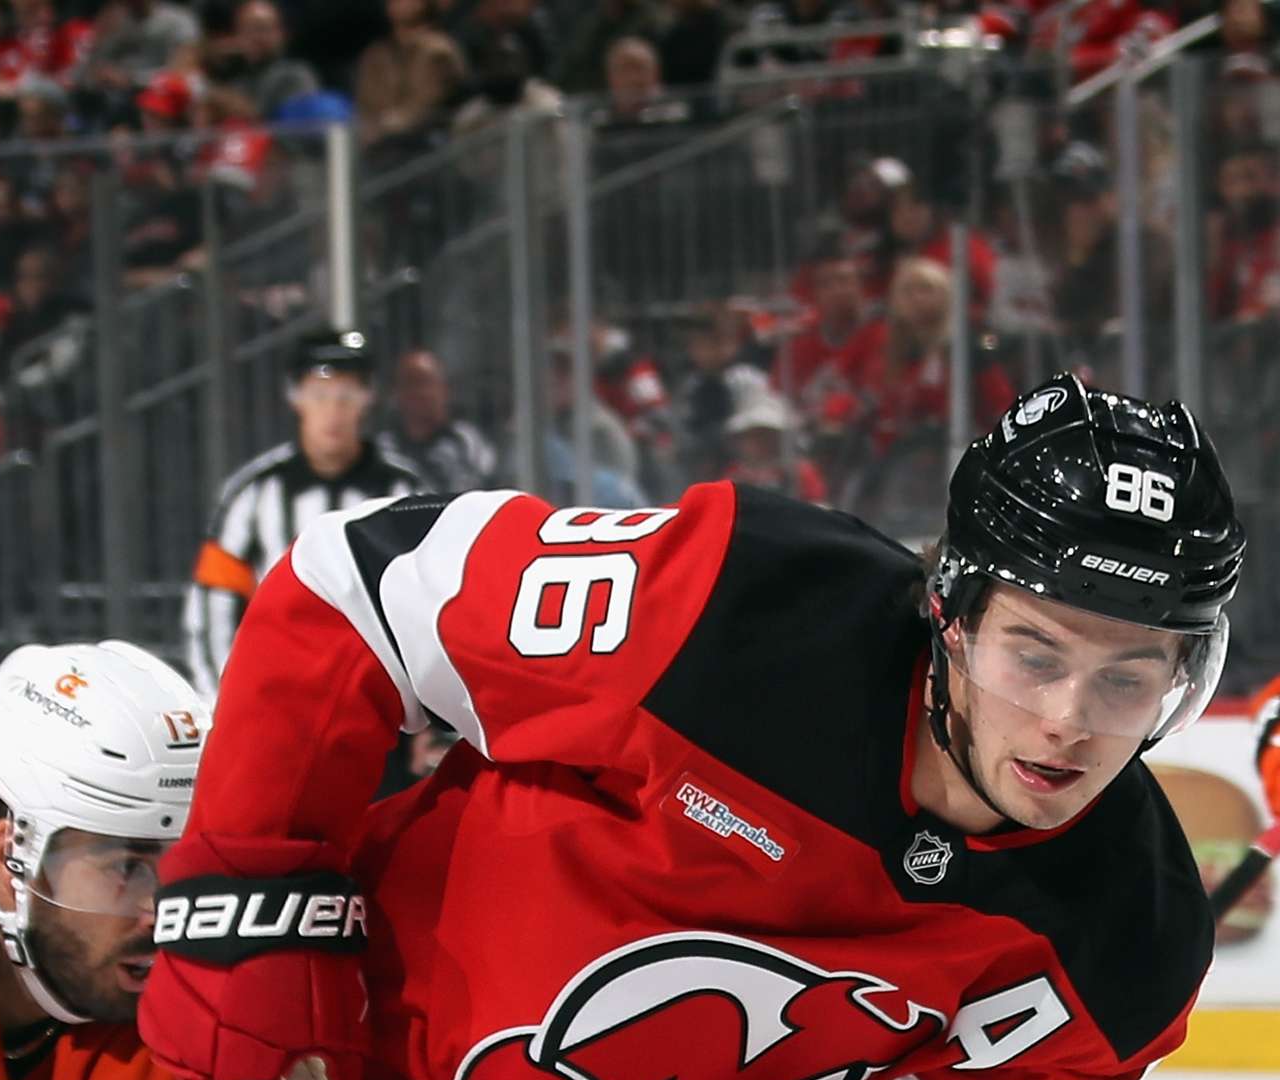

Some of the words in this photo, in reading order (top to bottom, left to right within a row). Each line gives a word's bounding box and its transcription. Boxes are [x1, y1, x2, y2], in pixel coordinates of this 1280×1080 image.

[1106, 463, 1175, 522] 86
[509, 507, 680, 656] 86
[1081, 554, 1170, 586] BAUER
[19, 681, 92, 729] Navigator
[162, 711, 200, 742] 13
[685, 805, 732, 837] HEALTH
[153, 892, 368, 944] BAUER
[946, 976, 1071, 1070] A
